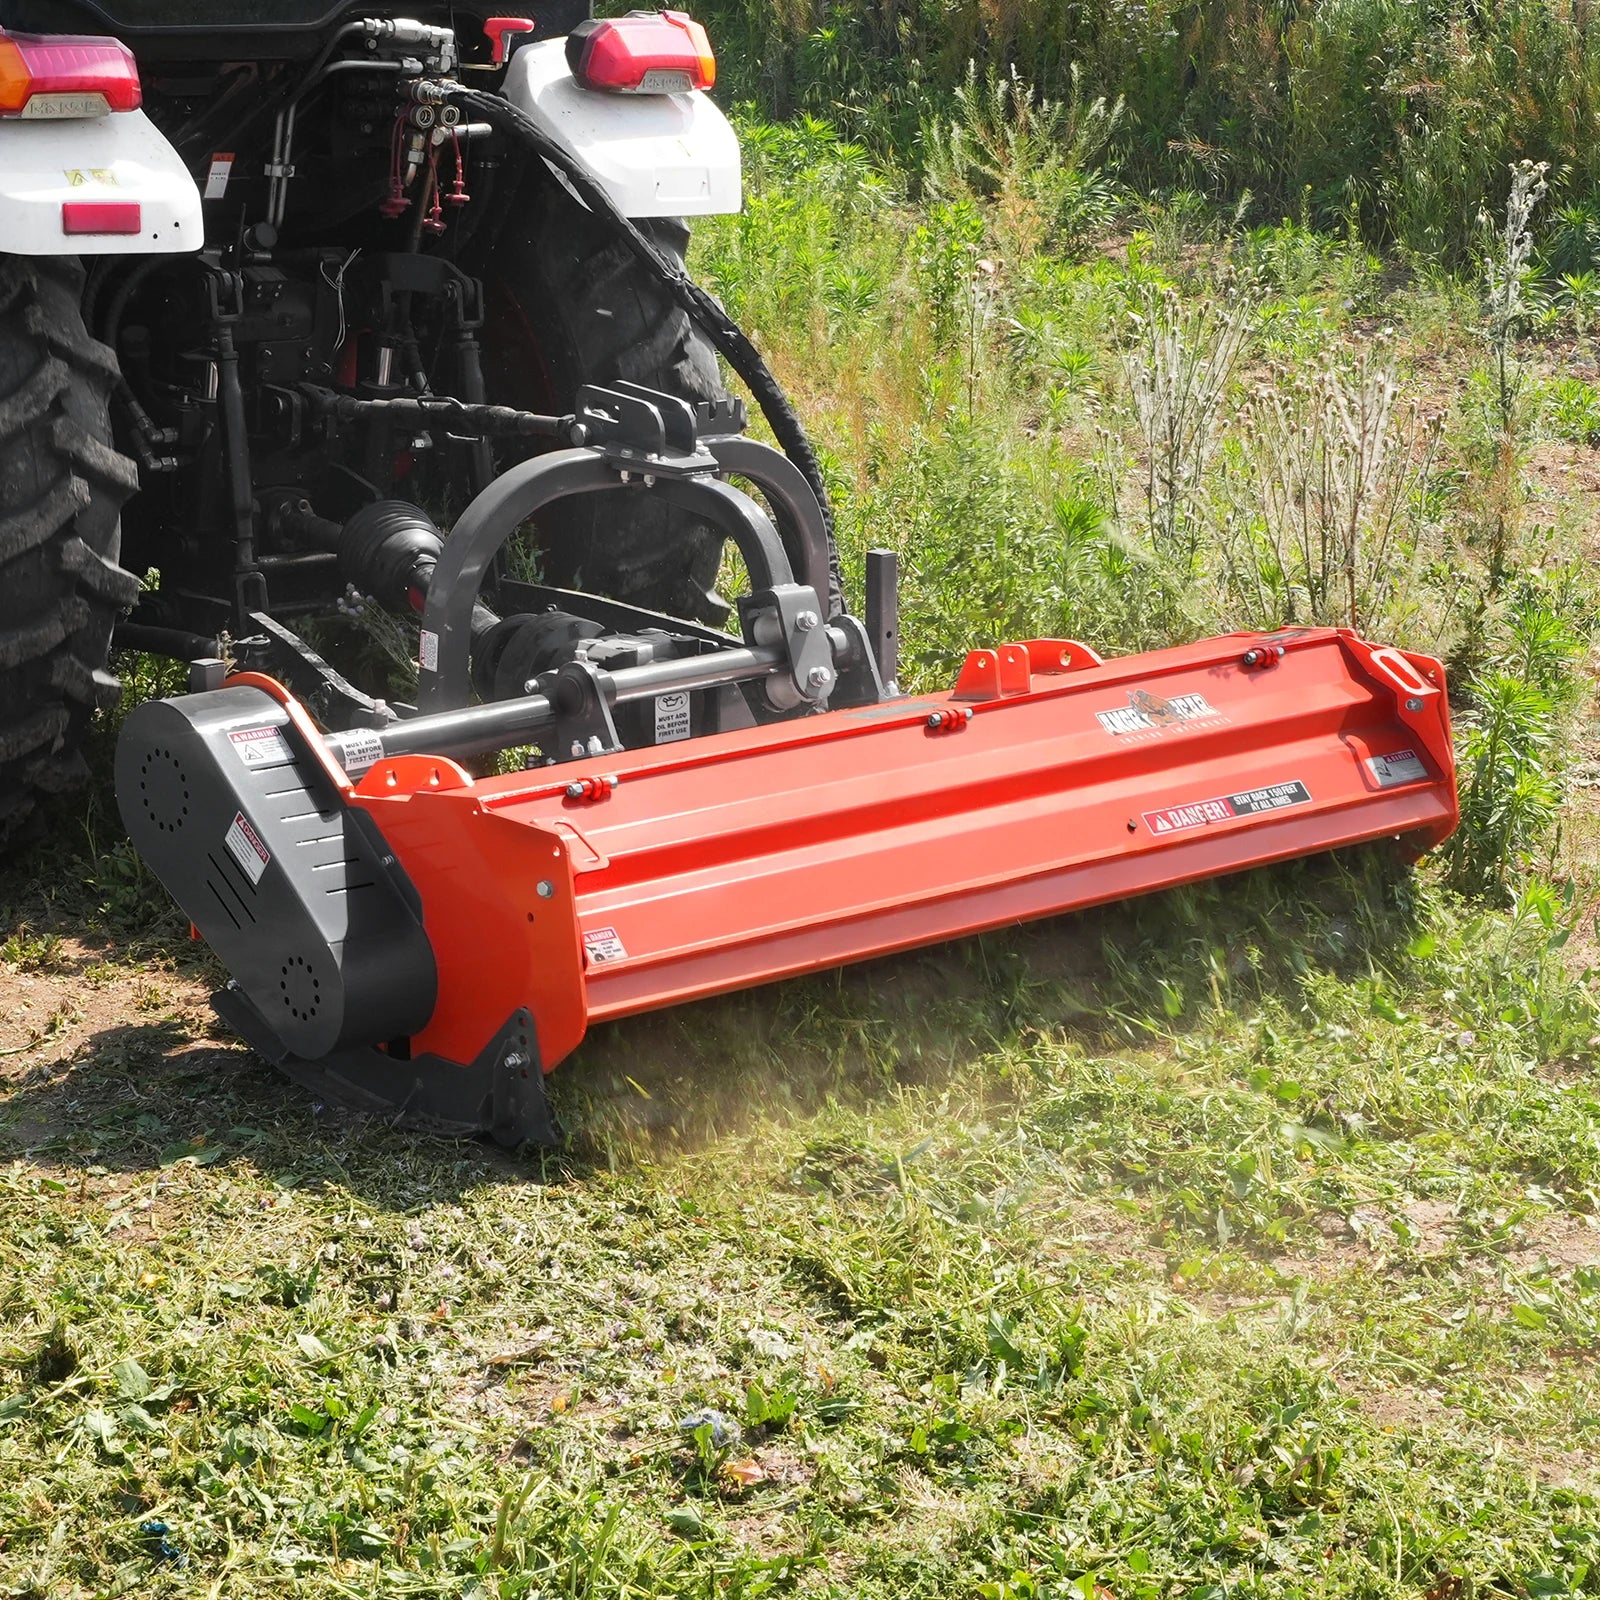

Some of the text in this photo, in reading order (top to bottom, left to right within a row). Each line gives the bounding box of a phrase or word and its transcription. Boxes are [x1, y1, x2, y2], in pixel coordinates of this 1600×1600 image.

[667, 719, 689, 728] BEFORE
[240, 728, 279, 740] WARNING
[345, 741, 363, 749] MUST
[358, 745, 382, 755] BEFORE
[1233, 783, 1299, 806] STAY BACK 150 FEET
[1250, 794, 1293, 812] AT ALL TIMES
[1167, 800, 1231, 828] DANGER!
[243, 823, 268, 862] DANGER
